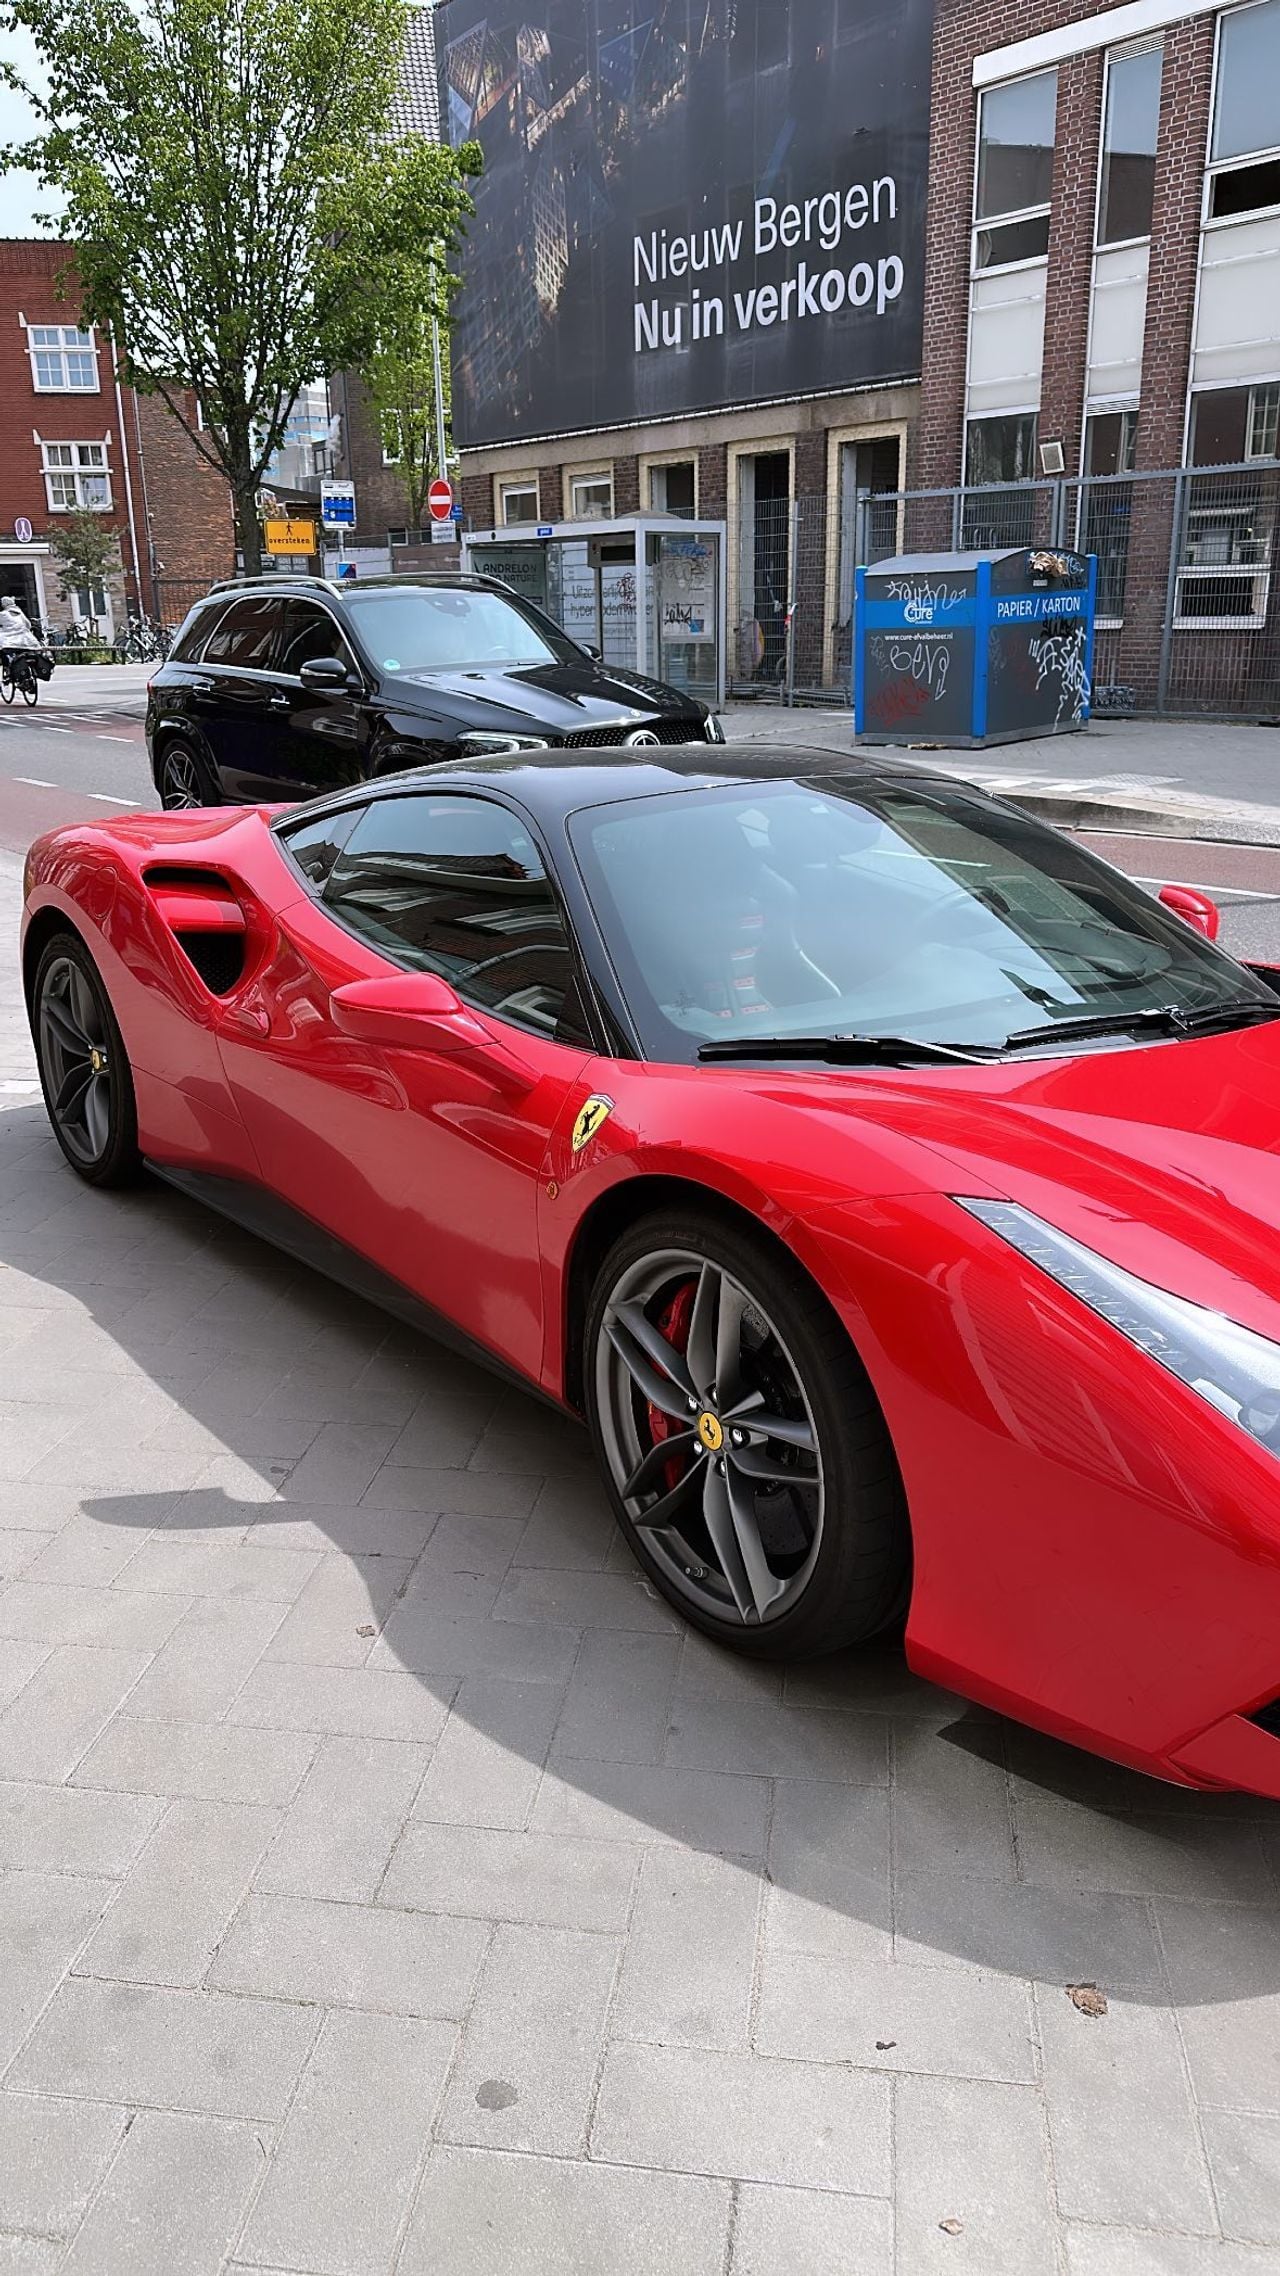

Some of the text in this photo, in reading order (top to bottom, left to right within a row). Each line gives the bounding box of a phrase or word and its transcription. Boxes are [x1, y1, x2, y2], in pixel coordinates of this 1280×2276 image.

[634, 176, 897, 287] Nieuw Bergen
[634, 255, 905, 352] Nu in verkoop
[268, 536, 310, 544] oversteken
[903, 602, 934, 623] Cure
[997, 596, 1081, 618] PAPIER / KARTON
